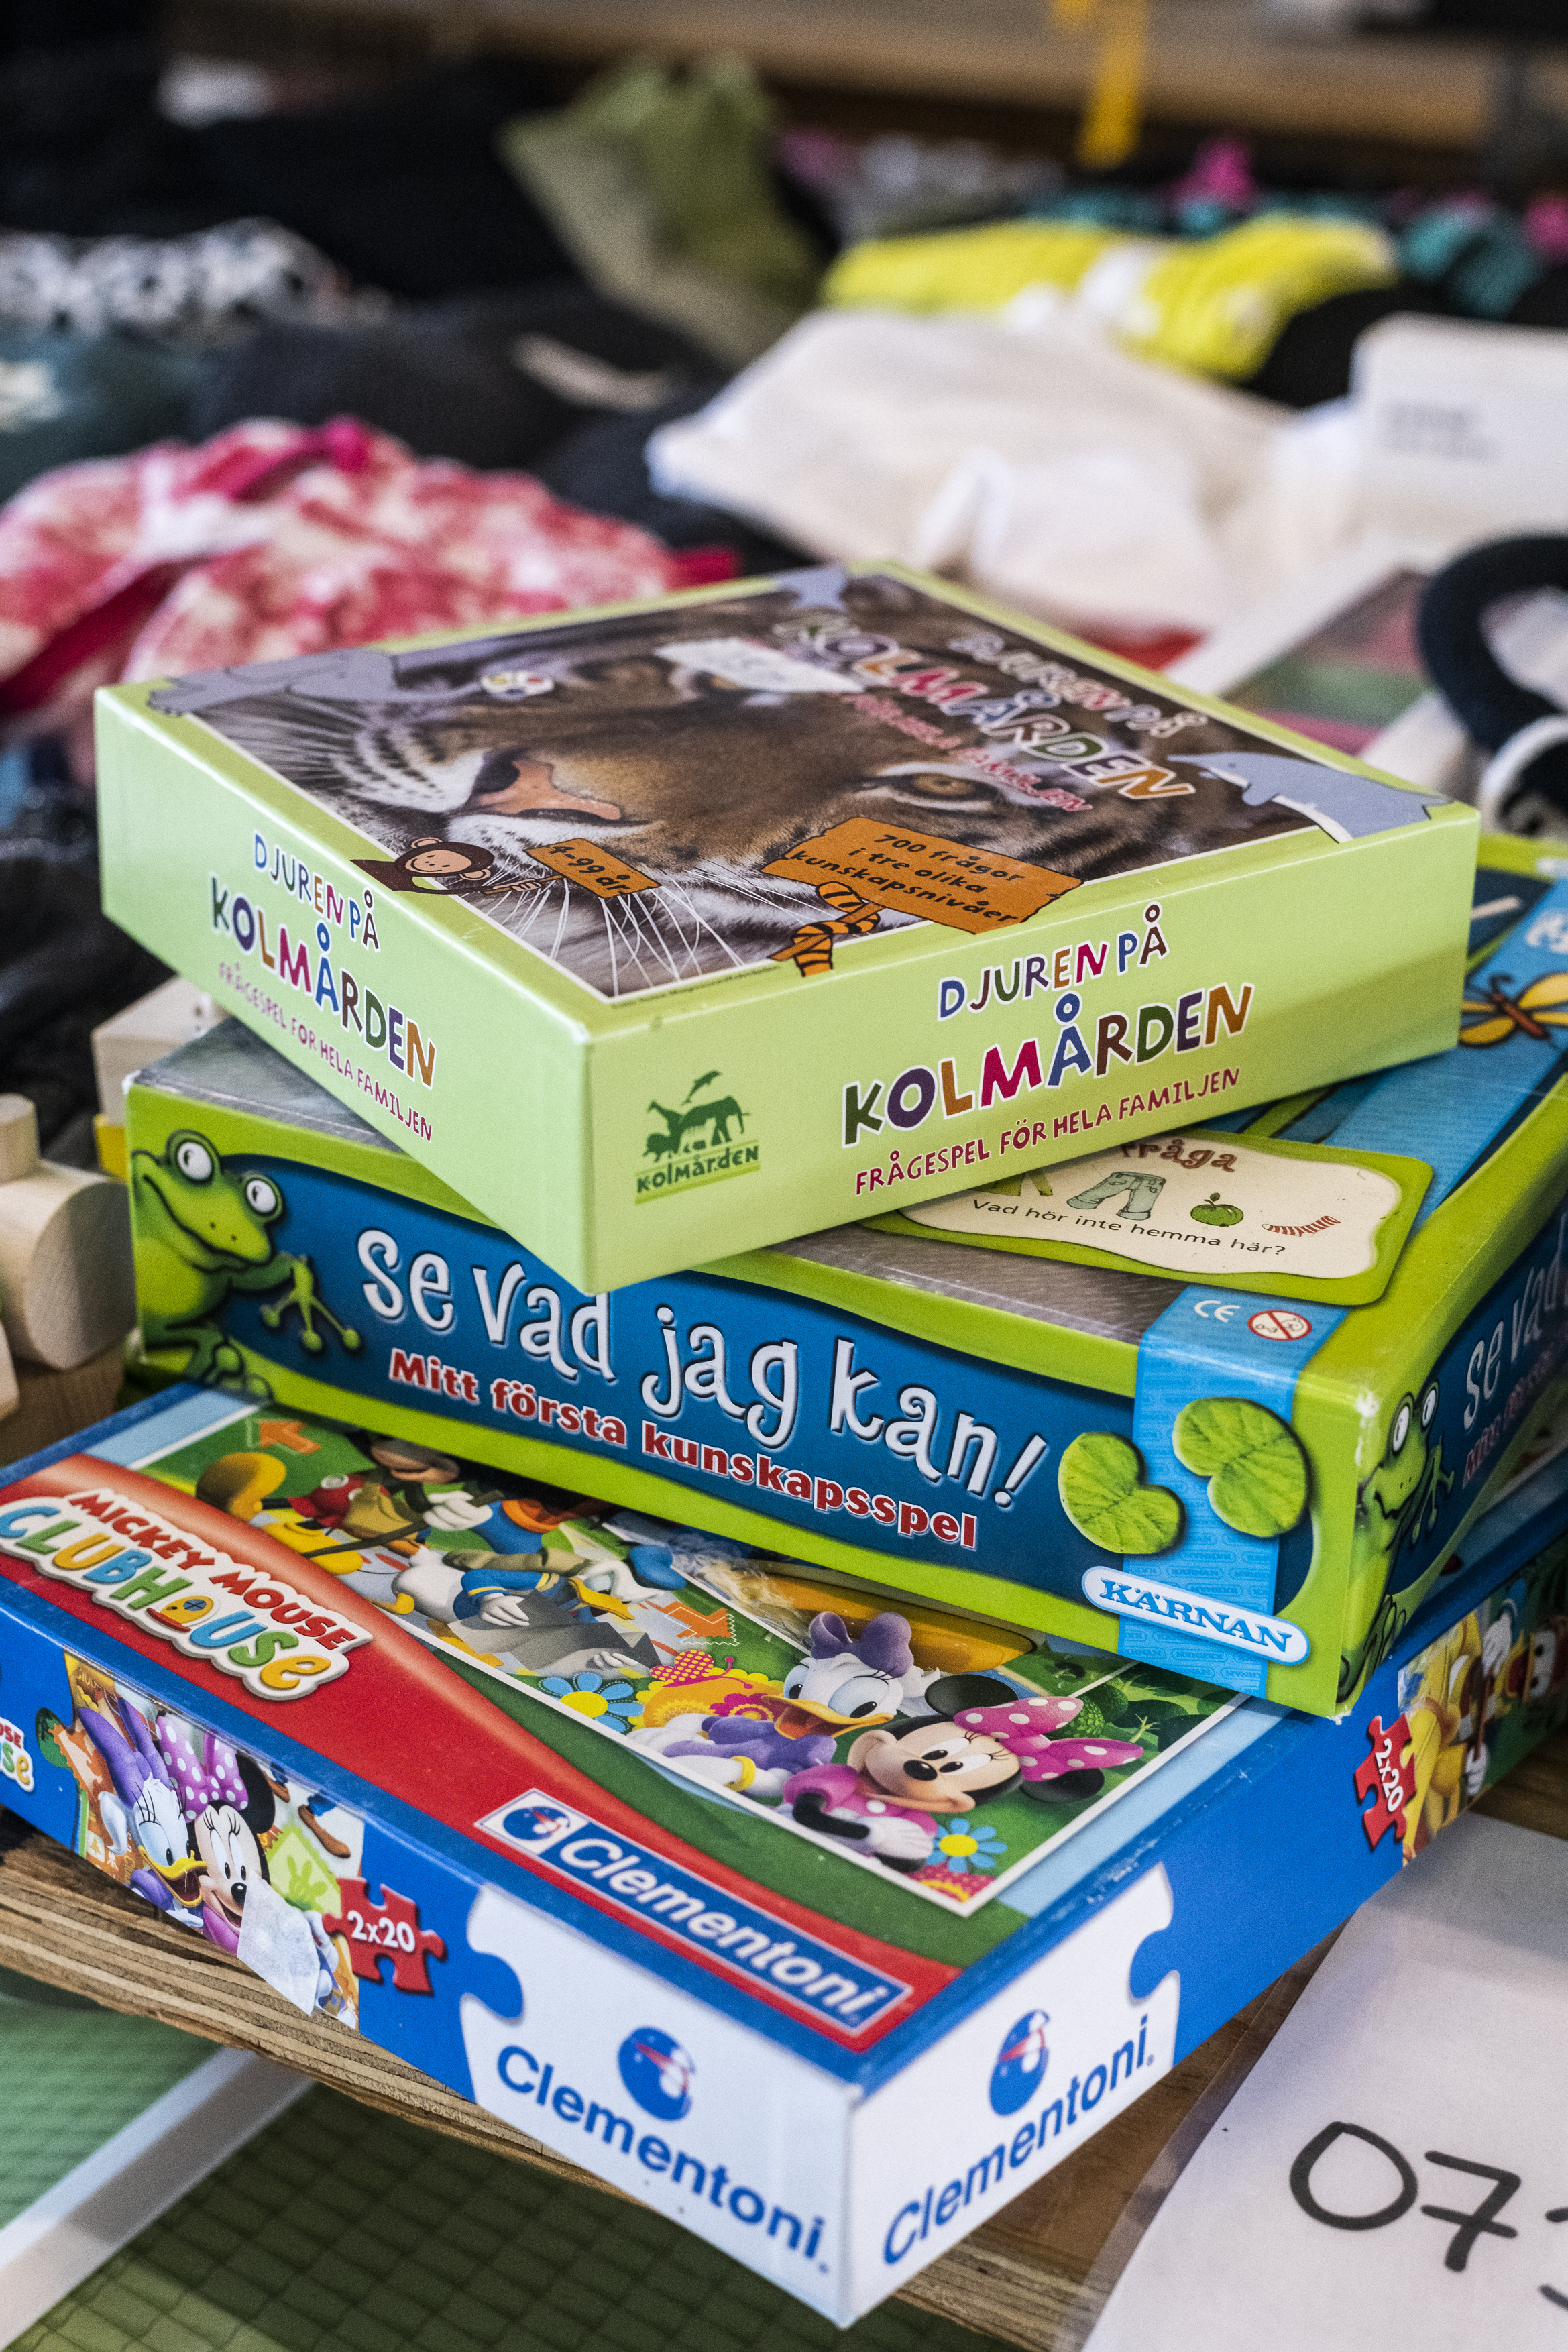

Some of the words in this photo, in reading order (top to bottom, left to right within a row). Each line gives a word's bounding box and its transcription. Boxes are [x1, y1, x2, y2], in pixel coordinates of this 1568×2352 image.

[771, 614, 1197, 799] KOLMÅRDEN
[254, 832, 345, 926] DJUREN
[348, 887, 381, 952] PÅ
[549, 846, 606, 873] 4-99
[595, 874, 631, 891] år
[788, 852, 1018, 926] kunskapsnivåer
[848, 847, 861, 857] i
[862, 854, 907, 871] tre
[915, 869, 989, 895] olika
[874, 835, 923, 853] 700
[932, 848, 1026, 884] frågor
[211, 875, 437, 1090] KOLMÅRDEN
[939, 939, 1111, 1022] DJUREN
[1116, 902, 1170, 974] PÅ
[218, 961, 287, 1031] FRÅGESPEL
[290, 1017, 317, 1054] FÖR
[320, 1040, 353, 1080] HELA
[357, 1066, 433, 1143] FAMILJEN
[842, 981, 1255, 1150] KOLMÅRDEN
[854, 1140, 991, 1196] FRÅGESPEL
[999, 1119, 1048, 1156] FÖR
[1052, 1100, 1113, 1139] HELA
[1119, 1068, 1241, 1121] FAMILJEN
[972, 1199, 1021, 1217] Vad
[1025, 1208, 1068, 1225] hör
[1074, 1214, 1122, 1231] inte
[1130, 1224, 1222, 1247] hemma
[1230, 1239, 1286, 1256] här?
[359, 1230, 454, 1333] Se
[473, 1261, 615, 1382] vad
[642, 1304, 798, 1449] jag
[830, 1338, 1048, 1509] kan!
[389, 1349, 479, 1403] Mitt
[491, 1378, 627, 1447] första
[642, 1420, 979, 1549] kunskapsspel
[69, 1490, 215, 1571] MICKEY
[209, 1571, 358, 1651] MOUSE
[1100, 1578, 1292, 1652] KÄRNAN
[1375, 1738, 1404, 1813] 2x20
[348, 1911, 415, 1952] 2x20
[559, 1835, 891, 2015] Clementoni
[496, 2044, 828, 2260] Clementoni
[883, 2014, 1150, 2267] Clementoni
